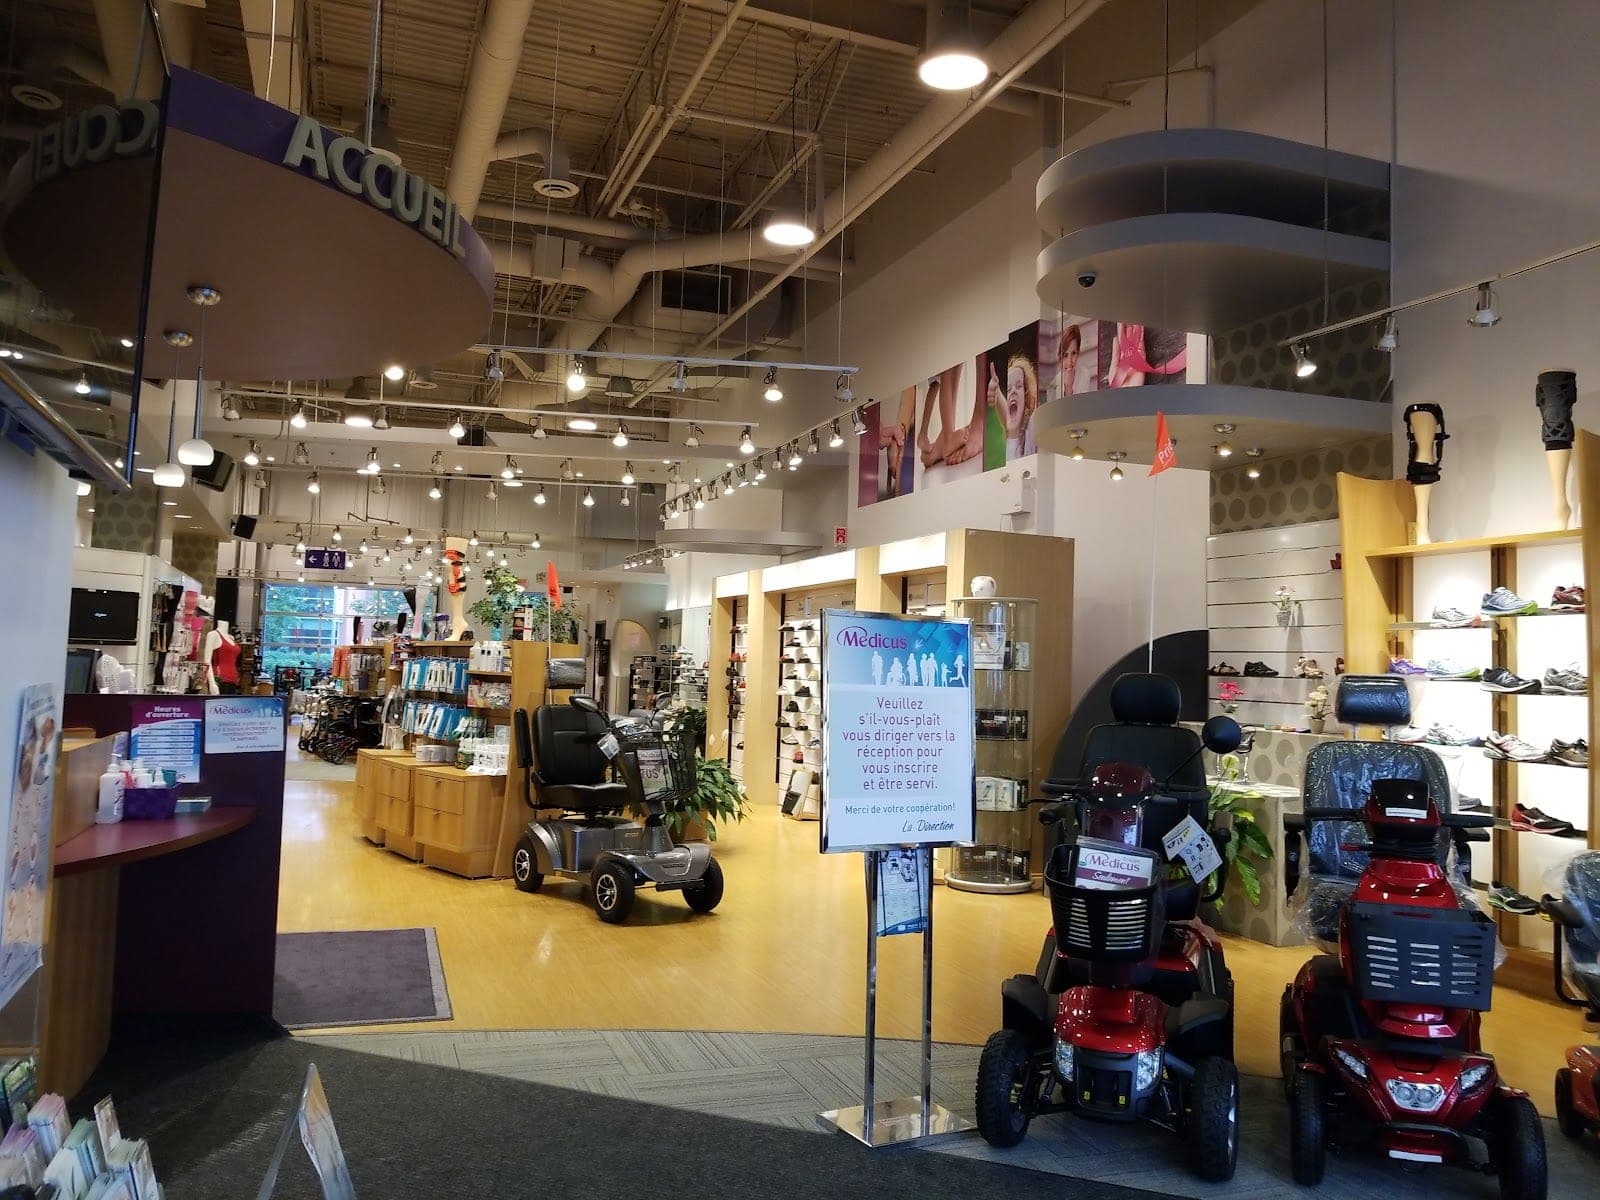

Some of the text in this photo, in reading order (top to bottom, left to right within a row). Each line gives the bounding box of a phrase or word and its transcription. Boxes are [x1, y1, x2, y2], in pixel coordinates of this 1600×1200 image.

[282, 115, 466, 257] ACCUEIL
[877, 697, 923, 710] Veuillez
[859, 712, 940, 726] s'il-vous-plaît
[843, 729, 955, 744] vous diriger vers la
[858, 746, 943, 760] réception pour
[863, 762, 938, 773] vous inscrire
[863, 777, 938, 790] et être servi.
[846, 803, 955, 814] Merci de votre coopération!
[903, 820, 954, 832] La Direction
